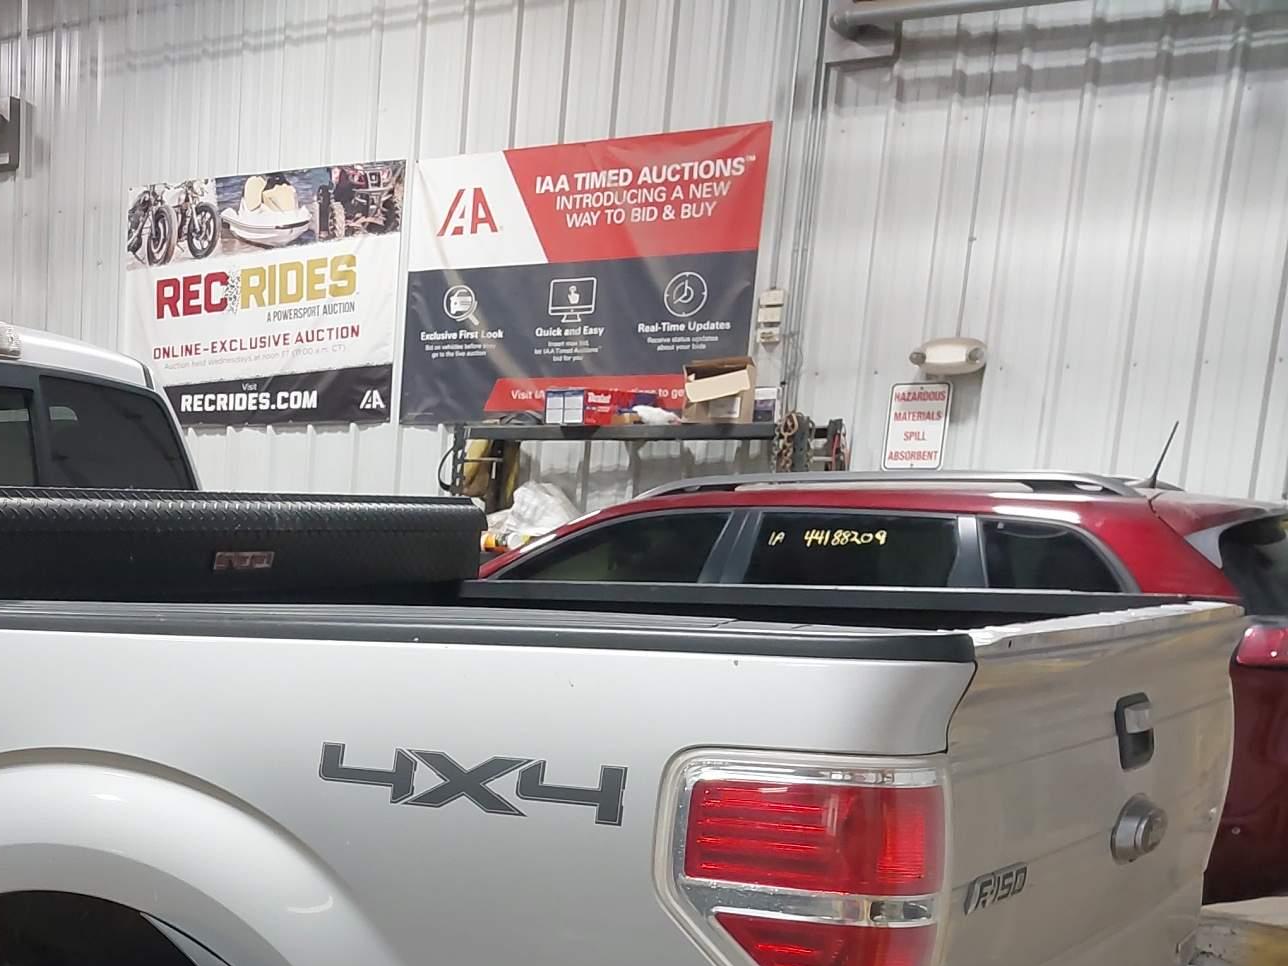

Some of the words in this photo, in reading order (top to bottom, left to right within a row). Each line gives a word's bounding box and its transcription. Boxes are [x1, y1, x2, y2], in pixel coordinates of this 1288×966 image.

[536, 175, 570, 194] IAA
[574, 169, 632, 190] TIMED
[556, 187, 666, 210] INTRODUCING
[670, 187, 684, 200] A
[689, 181, 731, 199] NEW
[566, 211, 601, 228] WAY
[605, 208, 626, 224] TO
[630, 208, 658, 222] BID
[662, 205, 676, 220] &
[680, 201, 717, 218] BUY
[156, 271, 230, 320] REC
[240, 254, 358, 310] RIDES
[266, 312, 272, 322] A
[273, 306, 321, 322] POWERSPORT
[323, 302, 355, 316] AUCTION
[535, 327, 562, 336] Quick
[564, 326, 581, 336] and
[583, 326, 605, 336] Easy
[638, 322, 685, 332] Real-Time
[688, 321, 731, 332] Updates
[420, 330, 458, 340] Exclusive
[459, 330, 479, 340] First
[481, 329, 504, 338] Look
[153, 332, 290, 360] ONLINE-EXCLUSIVE
[295, 325, 360, 345] AUCTION
[242, 383, 257, 391] Visit
[511, 390, 533, 400] Visit
[658, 388, 669, 398] to
[894, 390, 947, 402] HAZARDOUS
[180, 390, 318, 412] RECRIDES.COM
[893, 410, 943, 422] MATERIALS
[903, 430, 926, 441] SPILL
[888, 450, 939, 461] ABSORBENT
[804, 528, 888, 548] 44188209
